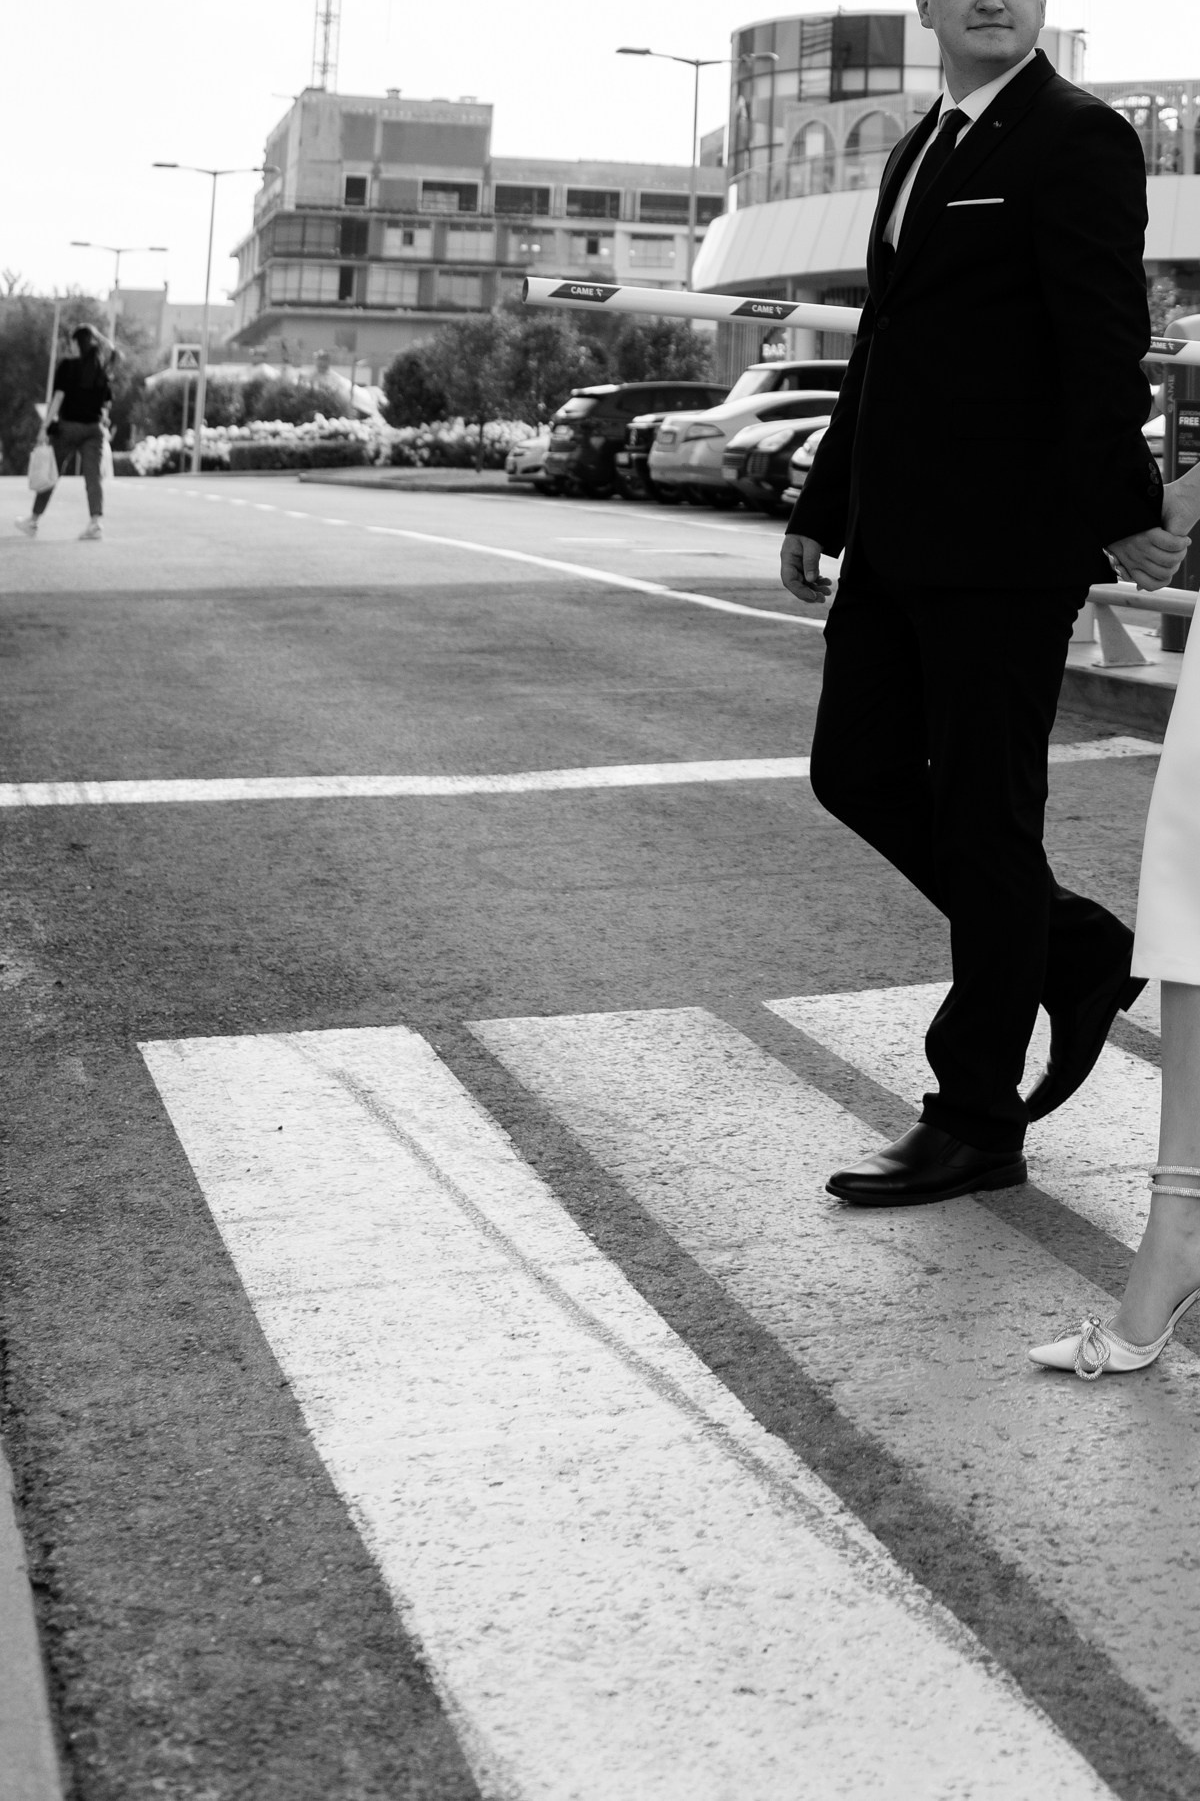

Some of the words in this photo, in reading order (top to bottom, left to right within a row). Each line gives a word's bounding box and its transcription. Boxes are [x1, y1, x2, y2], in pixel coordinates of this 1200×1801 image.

[570, 286, 594, 296] CAME
[751, 304, 774, 314] CAME
[1150, 341, 1167, 350] AME
[1179, 416, 1200, 427] FREE
